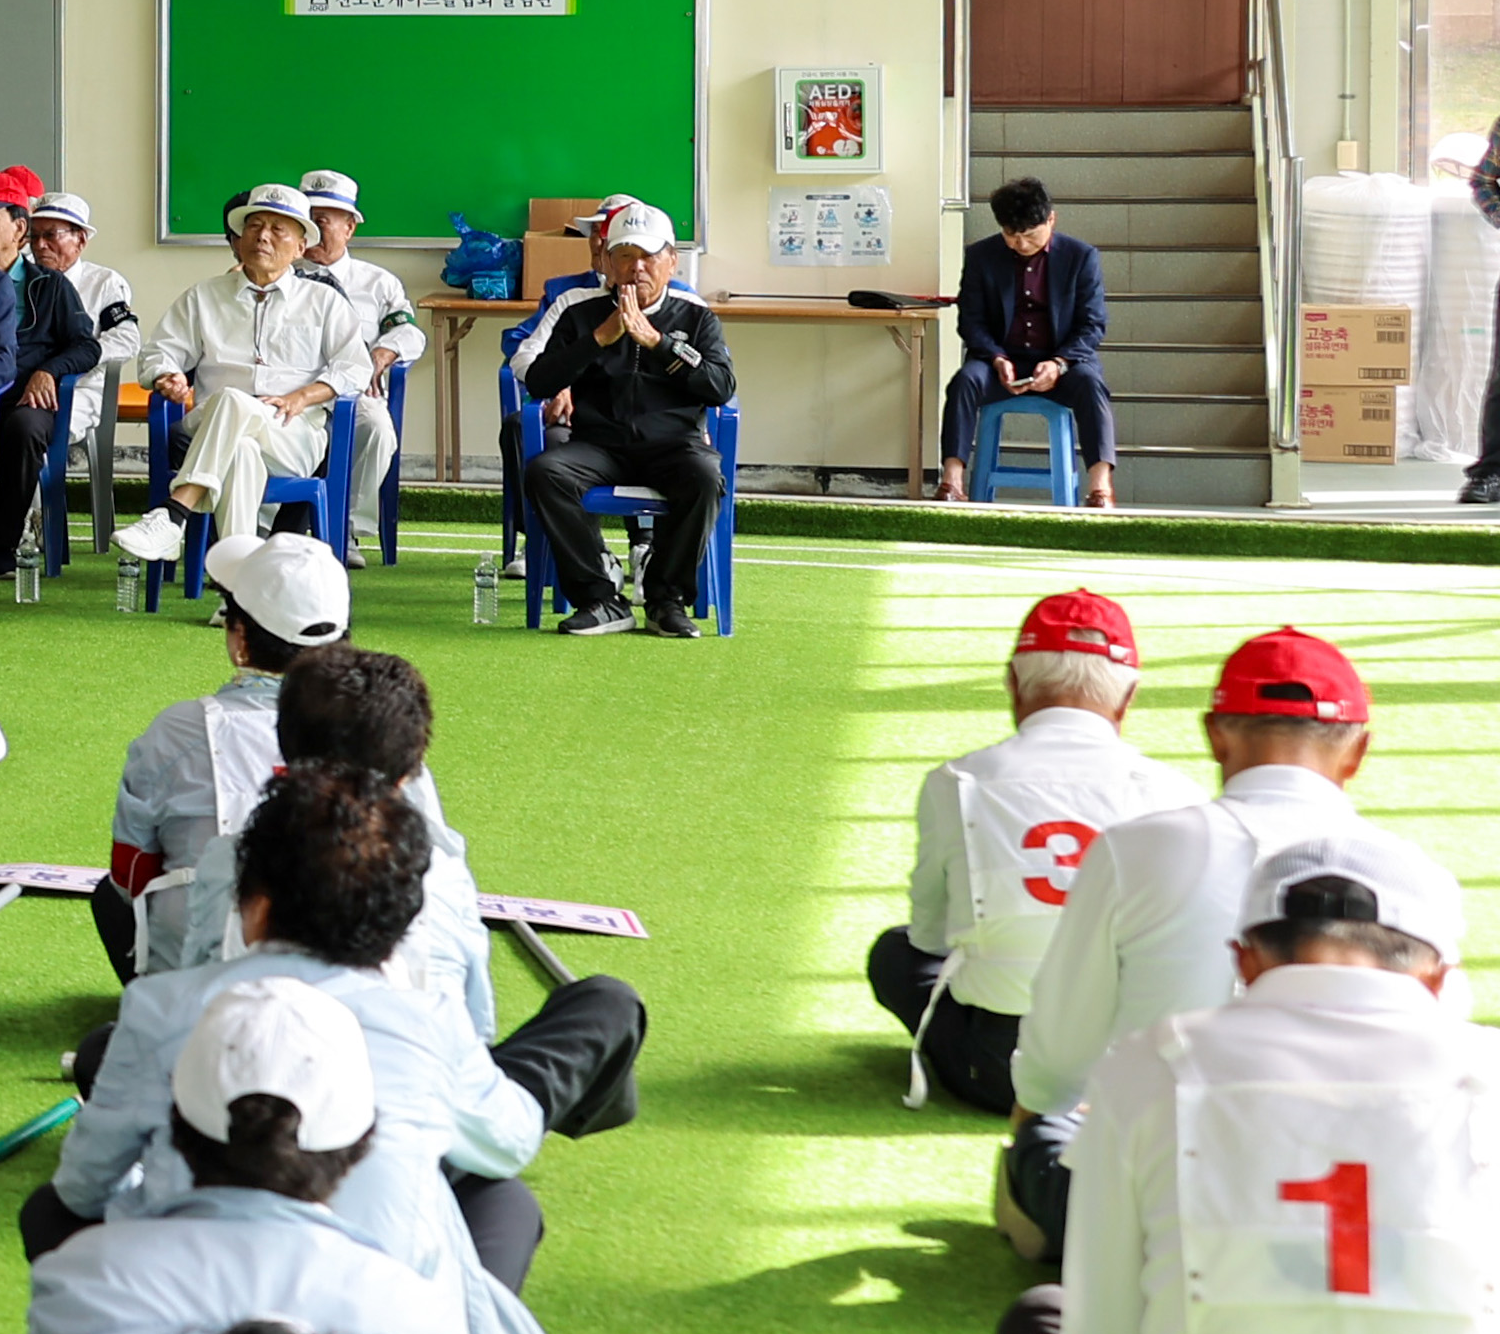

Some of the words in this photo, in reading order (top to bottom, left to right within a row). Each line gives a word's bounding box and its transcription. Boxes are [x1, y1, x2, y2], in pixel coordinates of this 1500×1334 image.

[808, 84, 852, 100] AED
[1020, 820, 1102, 907] 3
[1277, 1161, 1373, 1296] 1
